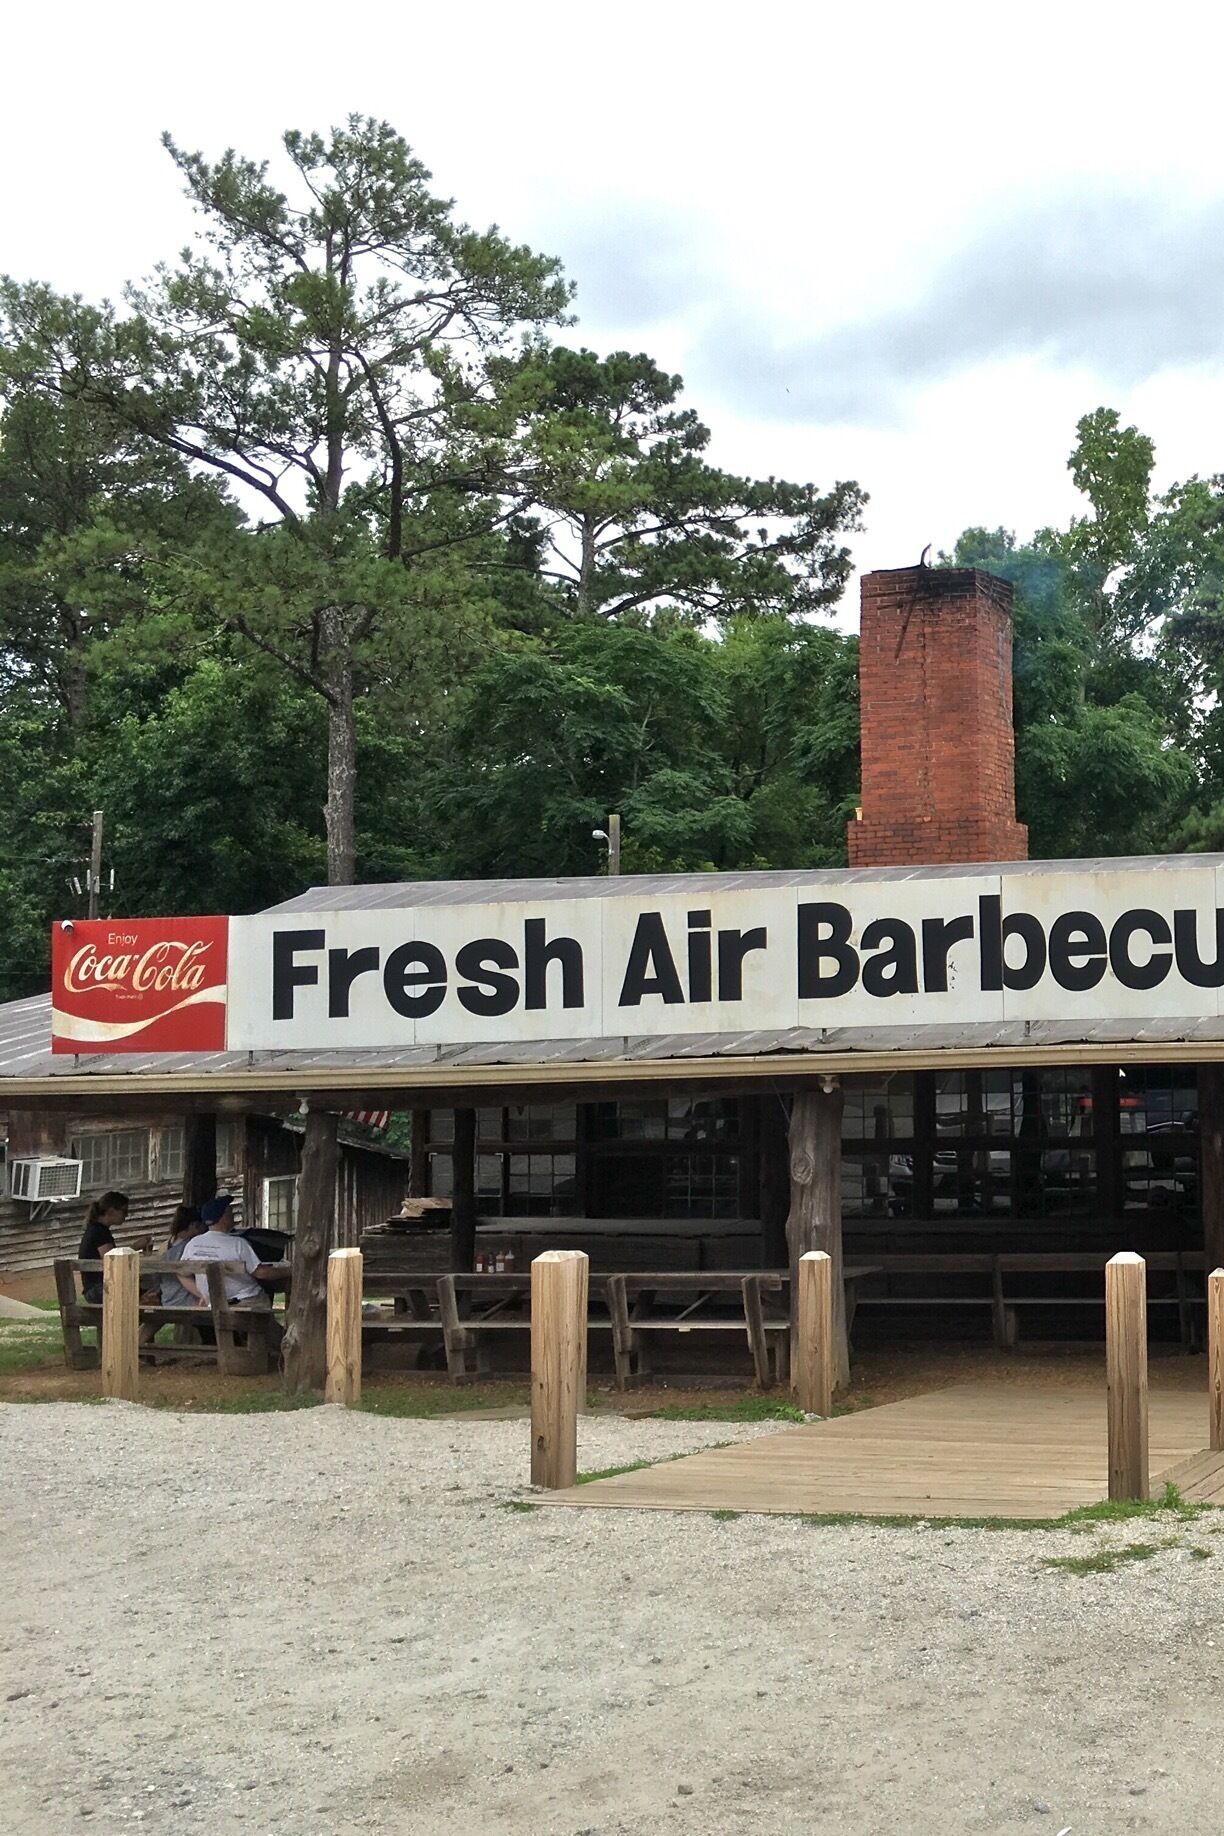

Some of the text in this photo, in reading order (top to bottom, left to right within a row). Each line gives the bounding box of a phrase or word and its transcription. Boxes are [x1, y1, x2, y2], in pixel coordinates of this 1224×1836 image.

[63, 940, 214, 993] Coca-Cola
[108, 933, 139, 947] Enjoy
[272, 917, 585, 1021] Fresh
[617, 909, 767, 1007] Air
